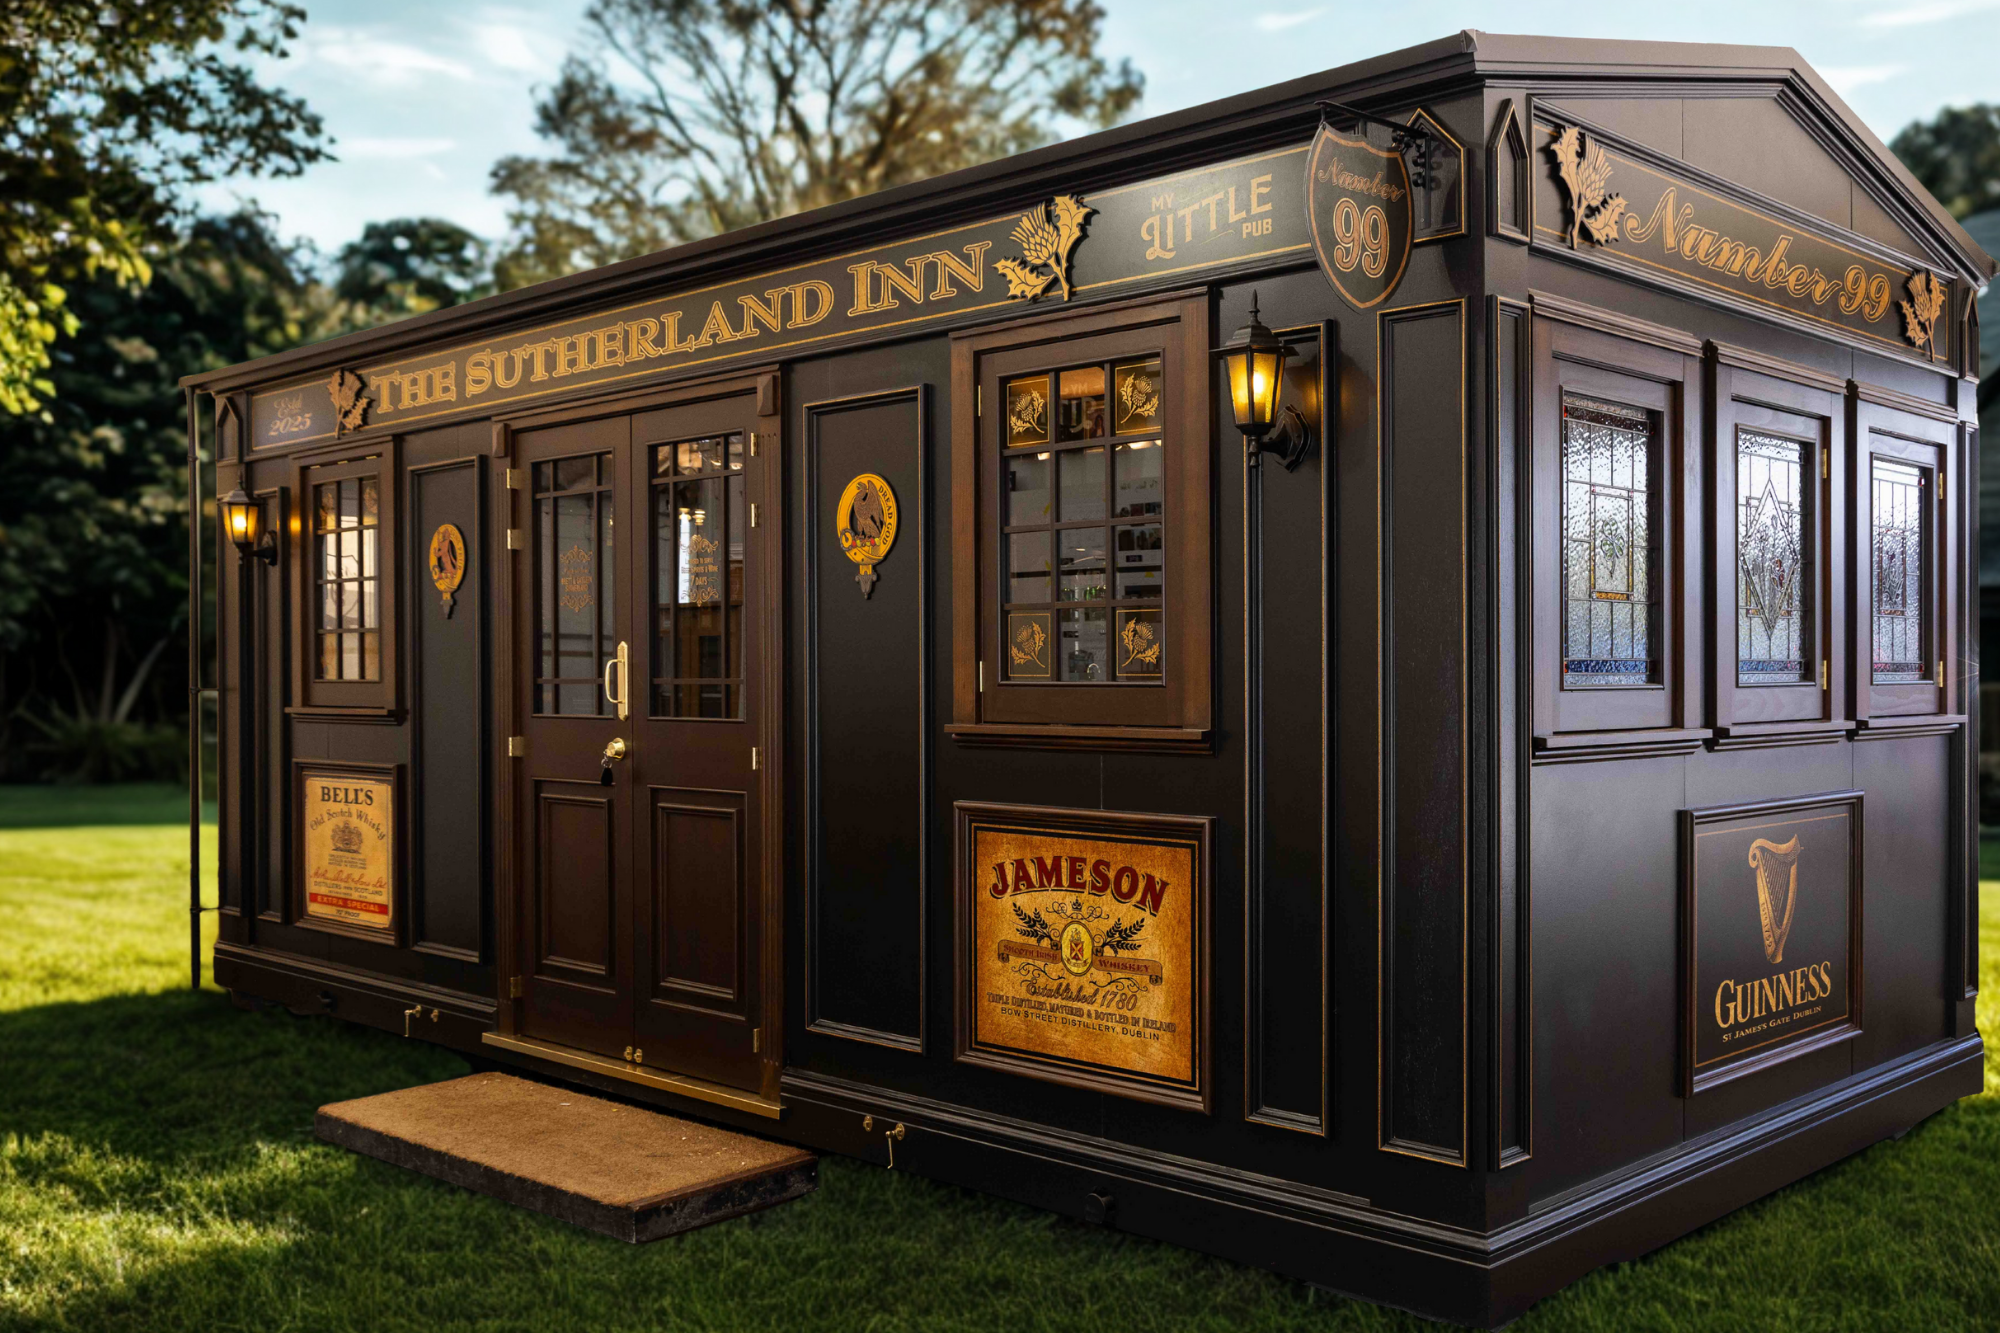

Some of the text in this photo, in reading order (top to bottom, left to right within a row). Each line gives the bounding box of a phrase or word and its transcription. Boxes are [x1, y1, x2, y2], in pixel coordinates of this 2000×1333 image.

[1318, 157, 1405, 202] Number
[1140, 173, 1273, 260] LITTLE
[1151, 193, 1175, 211] MY
[1242, 217, 1273, 239] PUB
[1333, 197, 1389, 278] 99
[1623, 186, 1891, 322] Number 99
[370, 240, 992, 414] THE SUTHERLAND INN
[268, 413, 311, 436] 2025
[878, 485, 893, 546] DREAD GOD
[691, 574, 696, 586] 7
[321, 786, 374, 806] BELL'S
[310, 807, 386, 841] Old Scotch Whisky
[317, 895, 379, 912] EXTRA SPECIAL
[989, 856, 1171, 917] JAMESON
[1098, 958, 1150, 973] WHISKEY
[1020, 977, 1138, 1012] Established 1780
[1715, 961, 1832, 1028] GUINNESS
[986, 992, 1010, 1005] TRIPLE
[1049, 1002, 1085, 1018] MATURED
[1086, 1008, 1093, 1019] &
[1094, 1009, 1129, 1025] BOTTLED
[1131, 1016, 1140, 1027] IN
[1143, 1017, 1177, 1033] IRELAND
[1001, 1006, 1160, 1041] BOW STREET DISTILLERY, DUBLIN
[1769, 1015, 1790, 1028] GATE
[1793, 1006, 1822, 1020] DUBLIN
